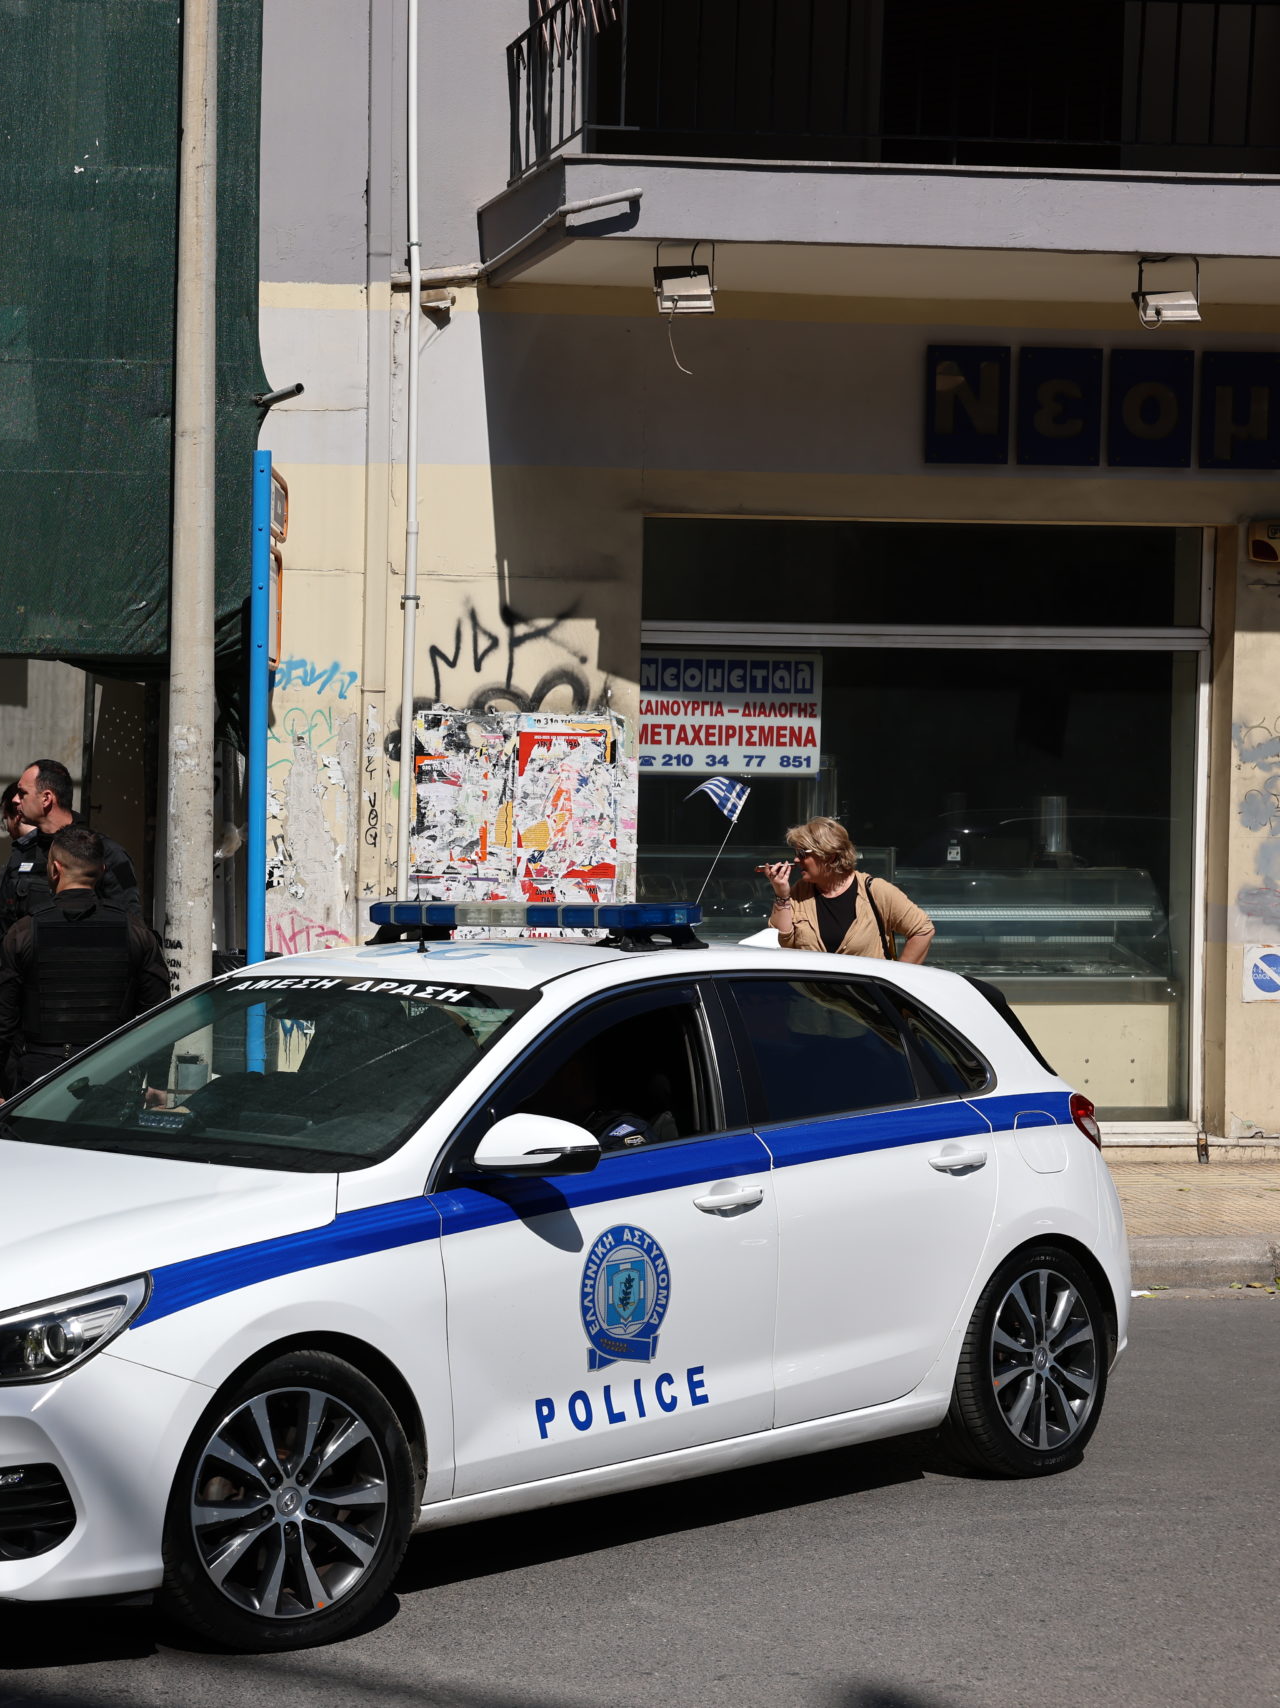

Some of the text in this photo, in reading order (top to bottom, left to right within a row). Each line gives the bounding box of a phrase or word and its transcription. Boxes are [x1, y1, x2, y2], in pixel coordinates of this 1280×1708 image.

[741, 702, 818, 719] ΔΙΑΛΟΓΗΣ
[661, 753, 812, 769] 210 34 77 851
[227, 978, 471, 1003] ΑΜΕΣΗ ΔΡΑΣΗ
[622, 1228, 669, 1326] ΑΣΤΥΝΟΜΙΑ
[535, 1365, 710, 1440] POLICE
